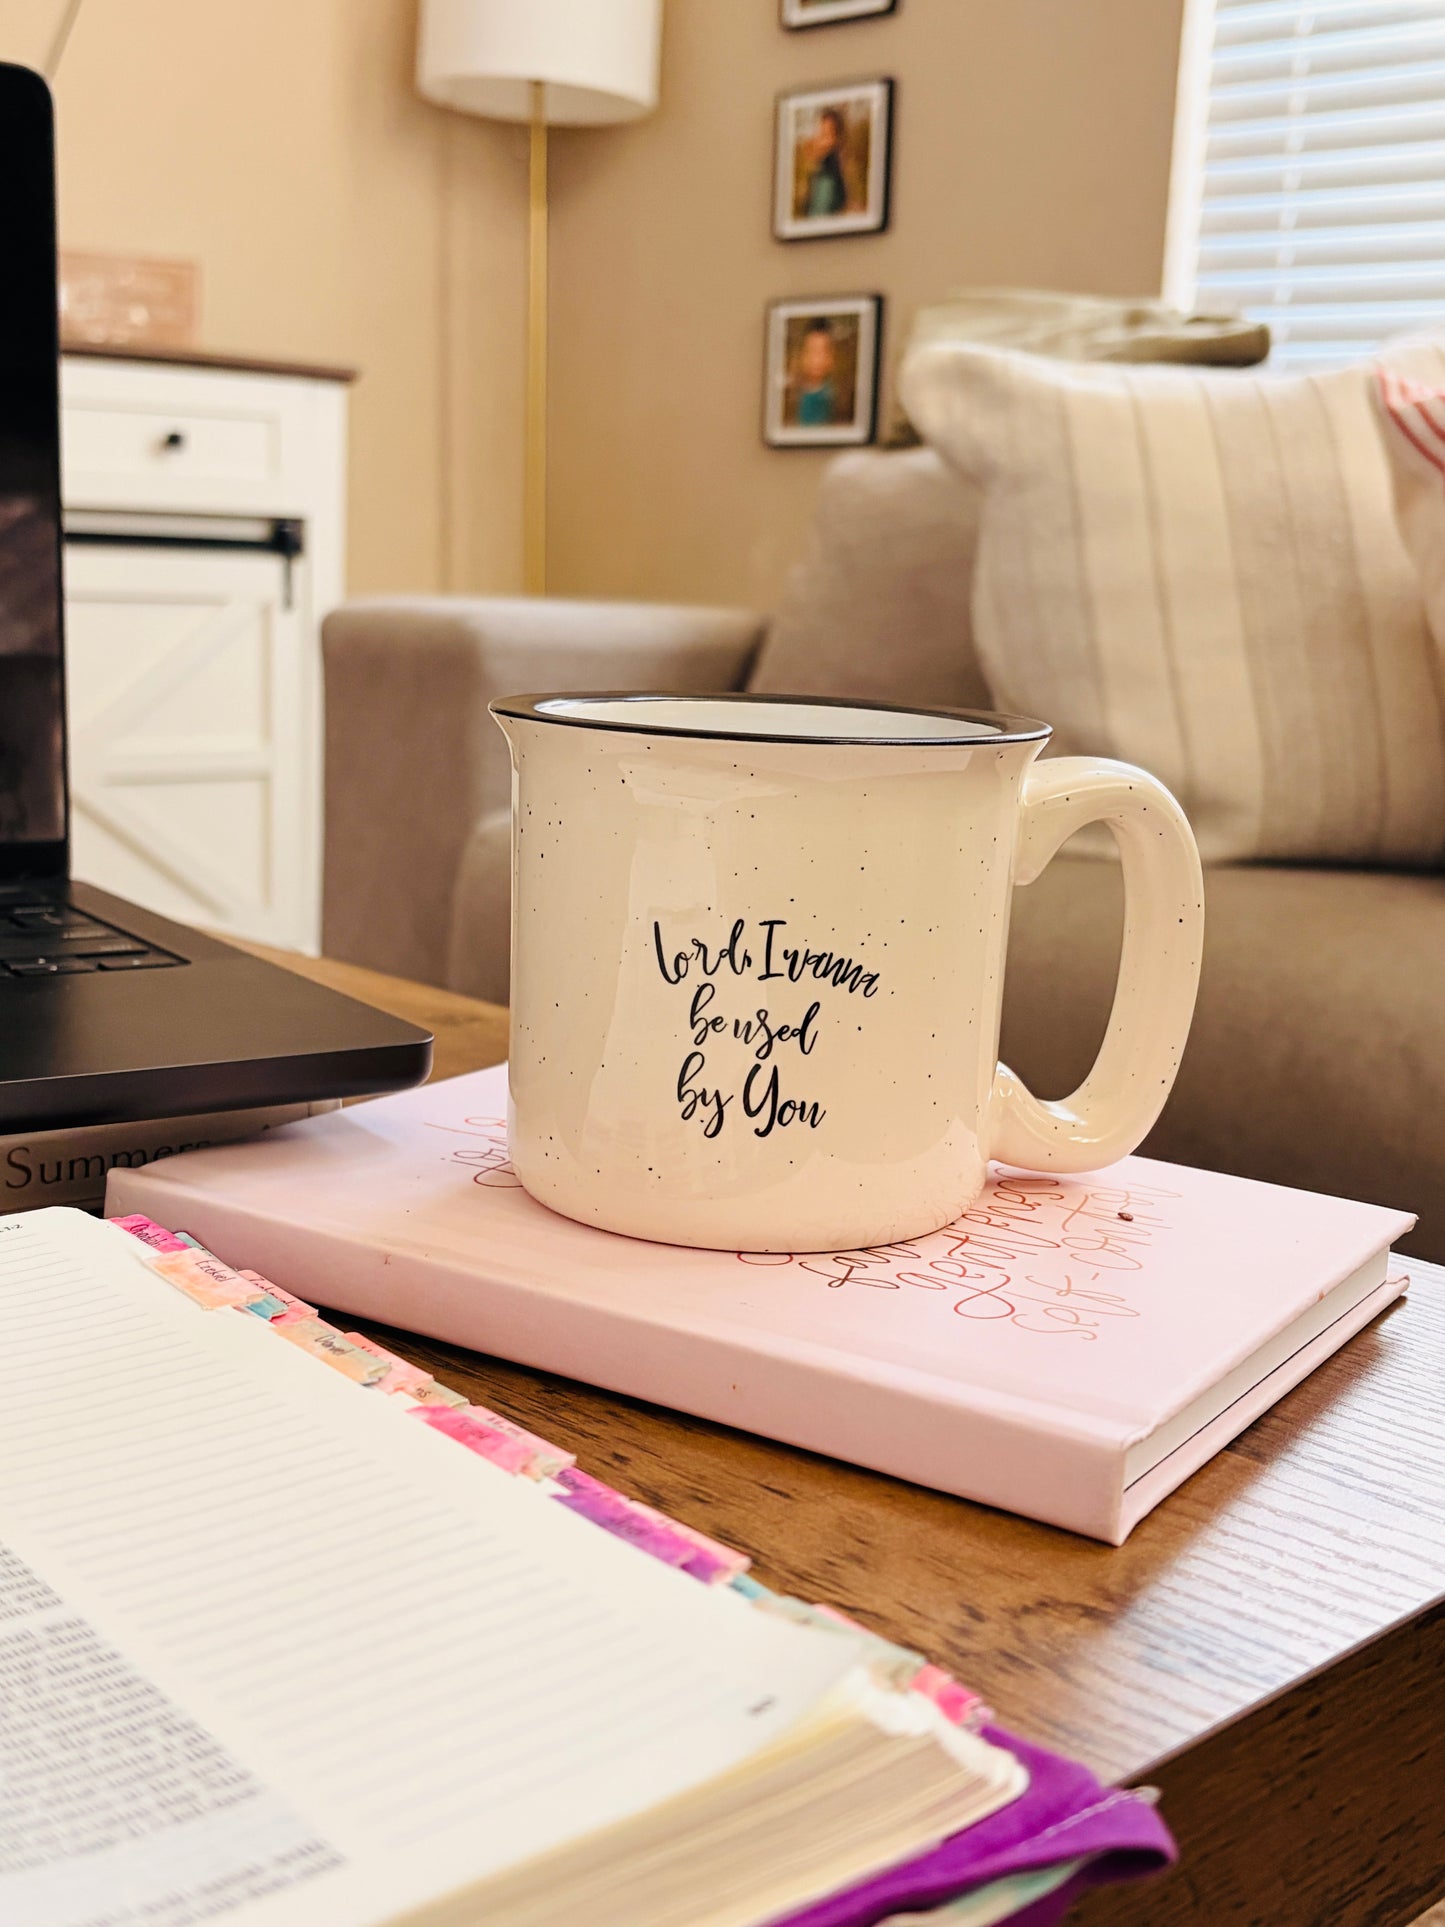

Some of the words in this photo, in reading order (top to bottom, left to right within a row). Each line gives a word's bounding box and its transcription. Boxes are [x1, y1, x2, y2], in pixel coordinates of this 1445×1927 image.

[757, 919, 787, 981] I
[690, 982, 728, 1046] be
[733, 1001, 821, 1060] used
[677, 1051, 734, 1138] by
[742, 1063, 826, 1138] You
